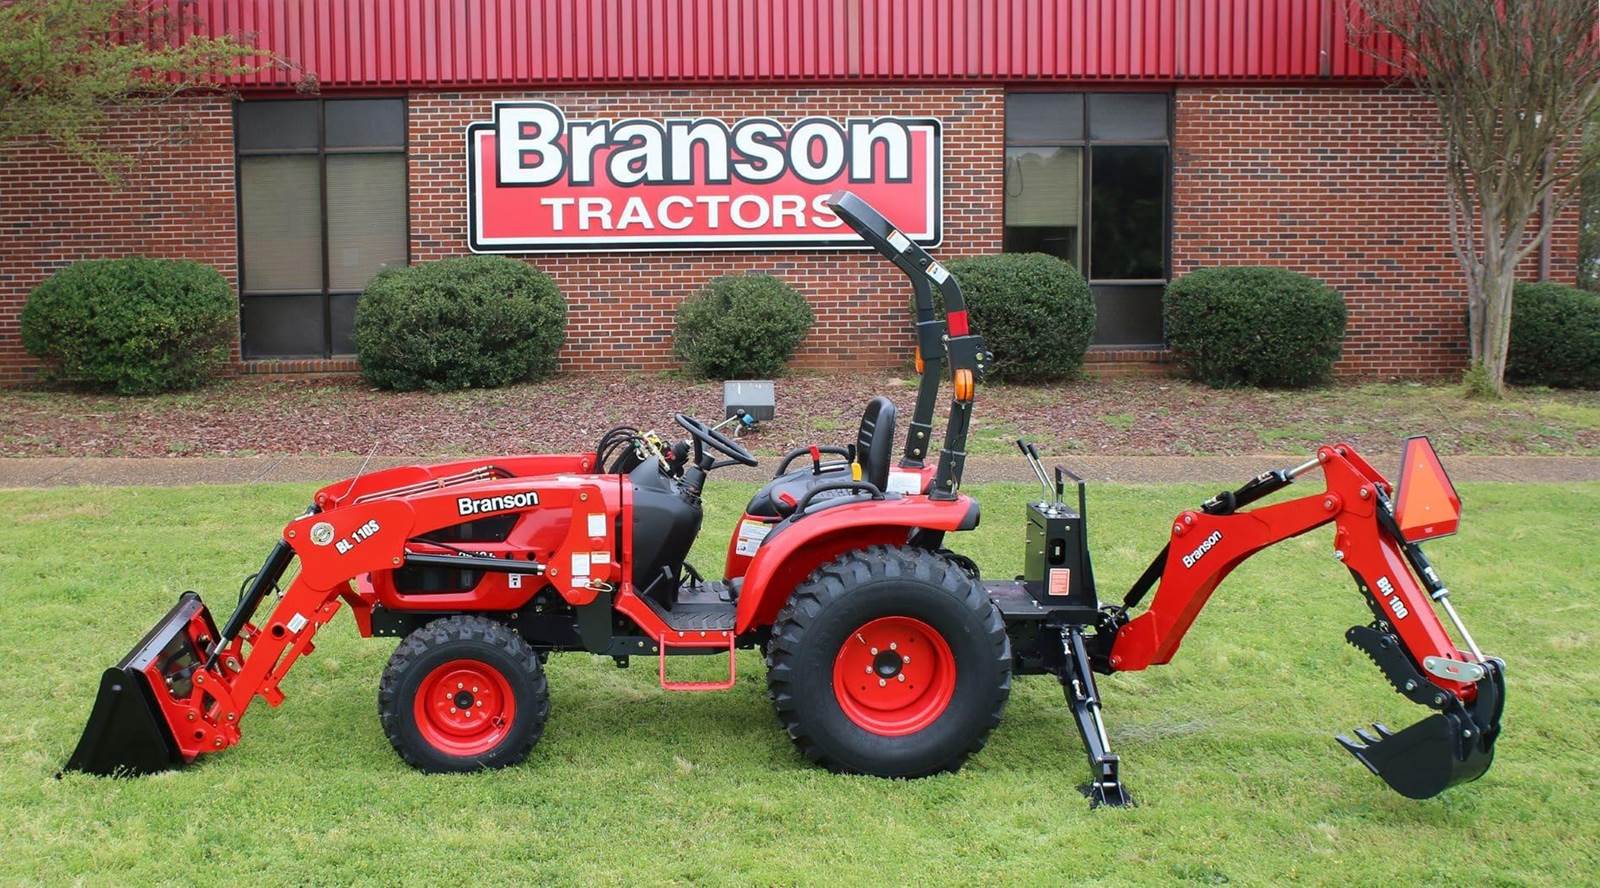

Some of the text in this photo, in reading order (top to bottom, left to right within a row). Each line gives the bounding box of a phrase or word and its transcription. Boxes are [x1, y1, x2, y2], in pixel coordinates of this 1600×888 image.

[498, 105, 911, 185] Branson
[457, 491, 539, 516] Branson
[335, 538, 354, 554] BL
[351, 519, 380, 543] 110S
[1182, 530, 1222, 569] Branson
[1376, 576, 1409, 619] BH 100
